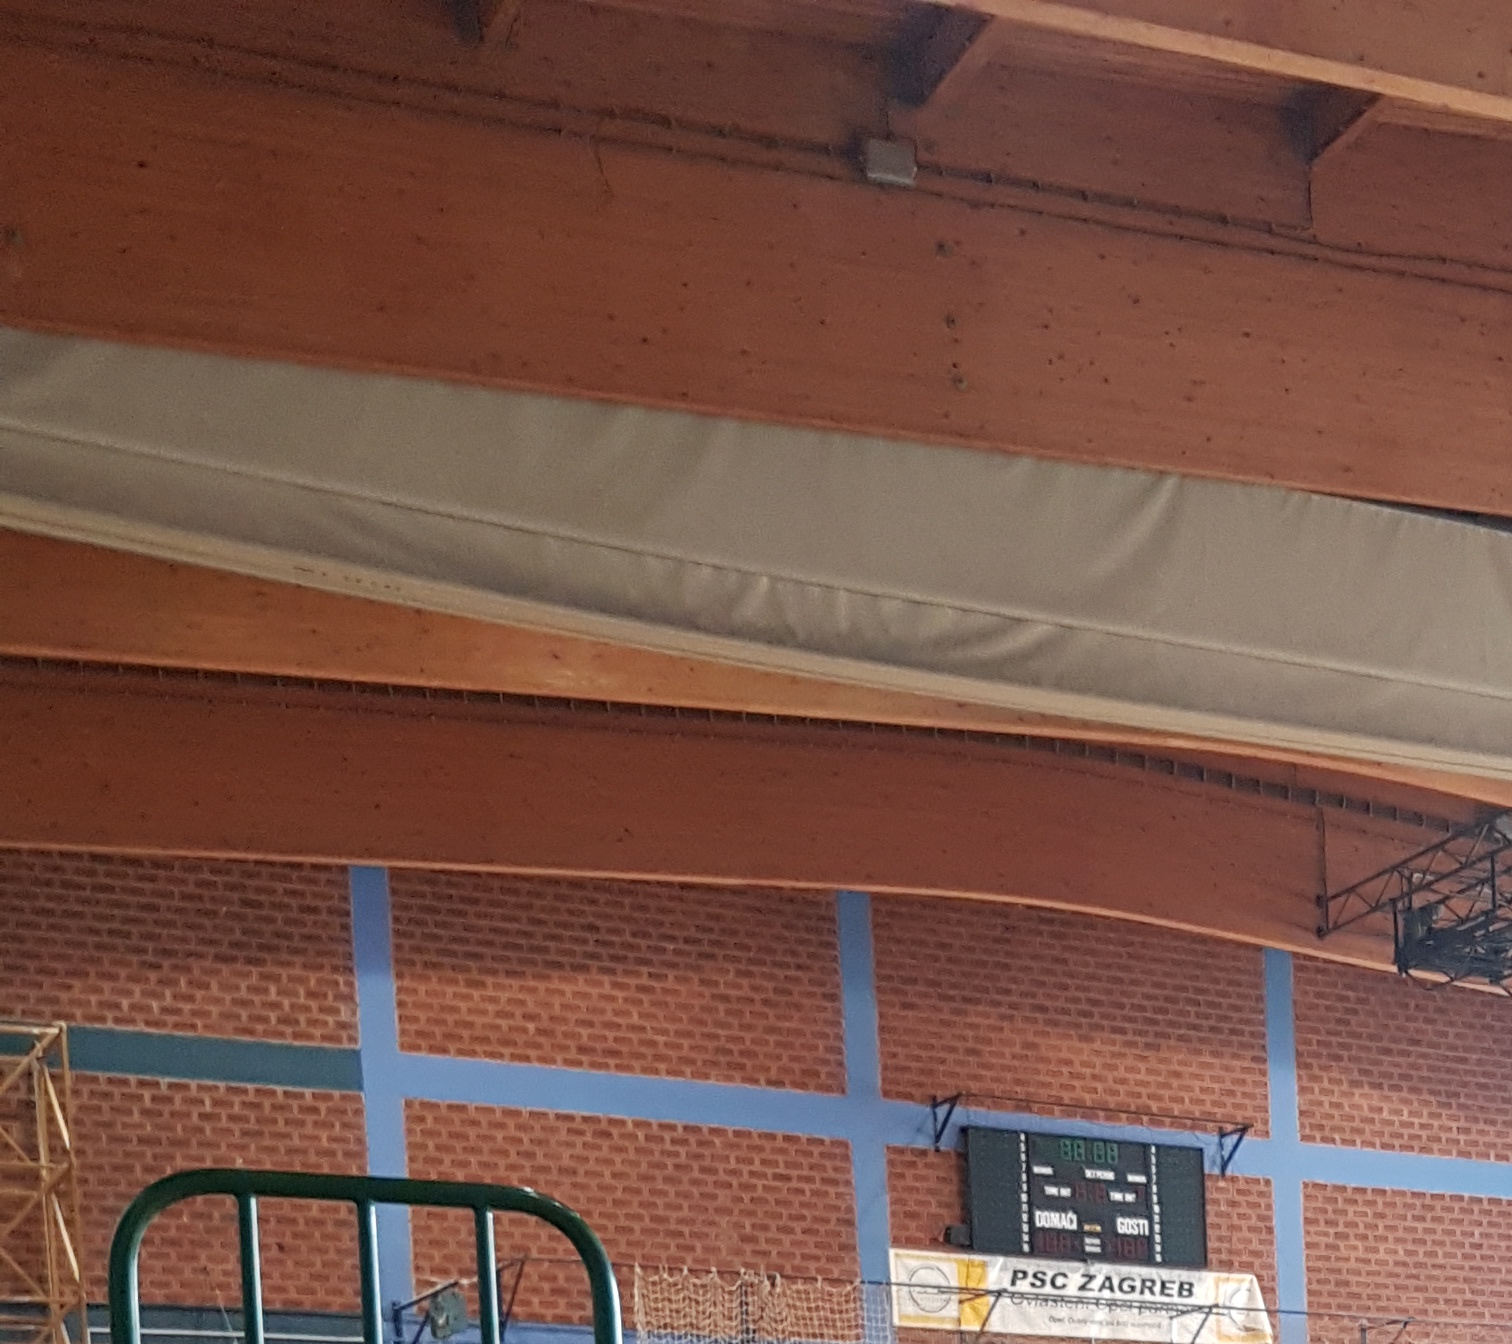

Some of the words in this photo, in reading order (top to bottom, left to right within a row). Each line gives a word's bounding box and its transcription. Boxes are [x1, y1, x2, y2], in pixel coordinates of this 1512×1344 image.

[1116, 1216, 1149, 1236] GOSTI
[1010, 1269, 1069, 1290] PSC
[1078, 1273, 1195, 1299] ZAGREB
